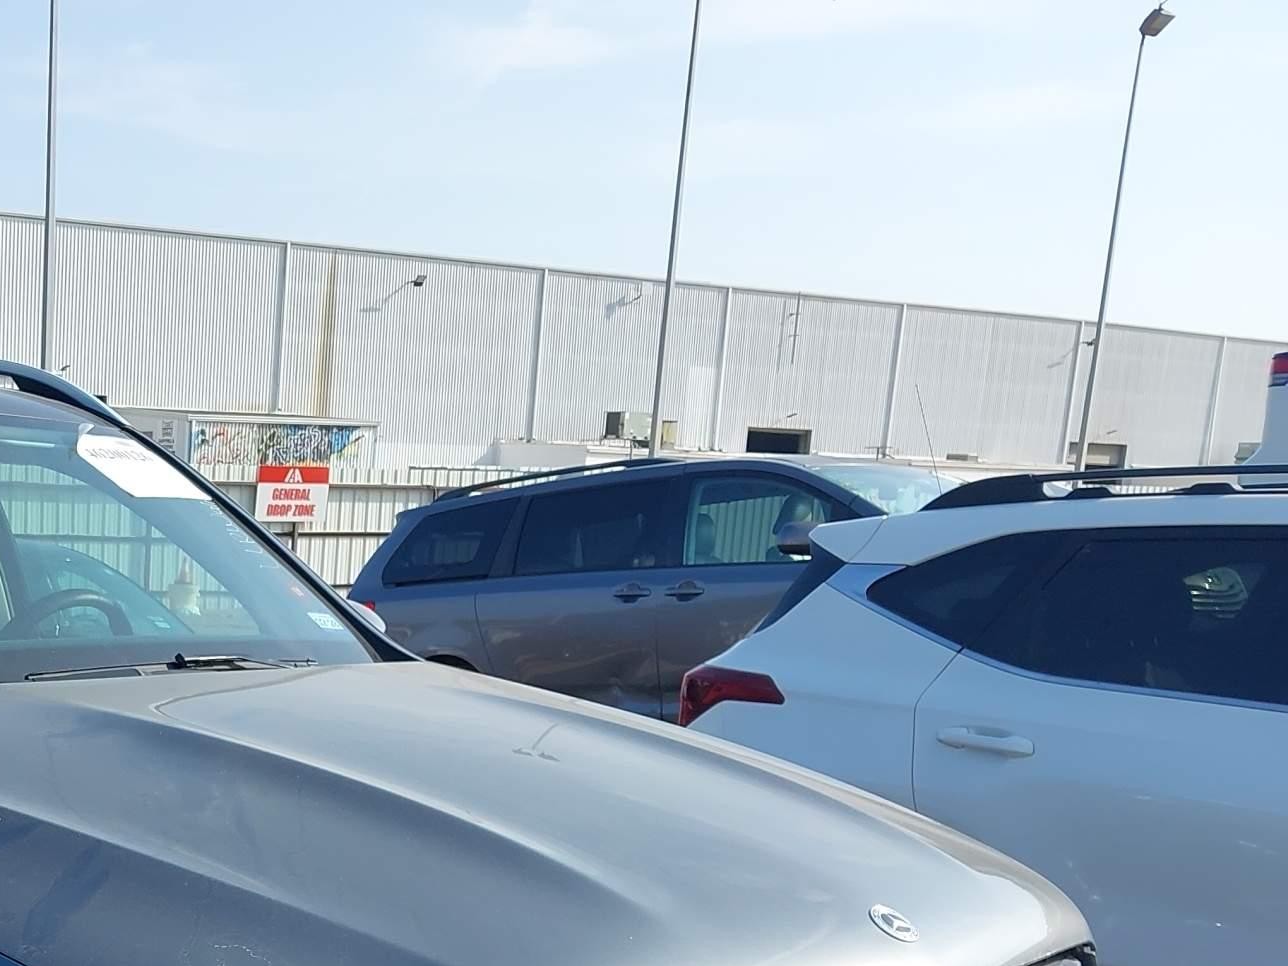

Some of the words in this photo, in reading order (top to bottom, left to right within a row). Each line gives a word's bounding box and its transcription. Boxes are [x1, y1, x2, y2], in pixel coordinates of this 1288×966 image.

[272, 488, 311, 501] GENERAL
[266, 504, 292, 516] DROP
[292, 504, 316, 517] ZONE
